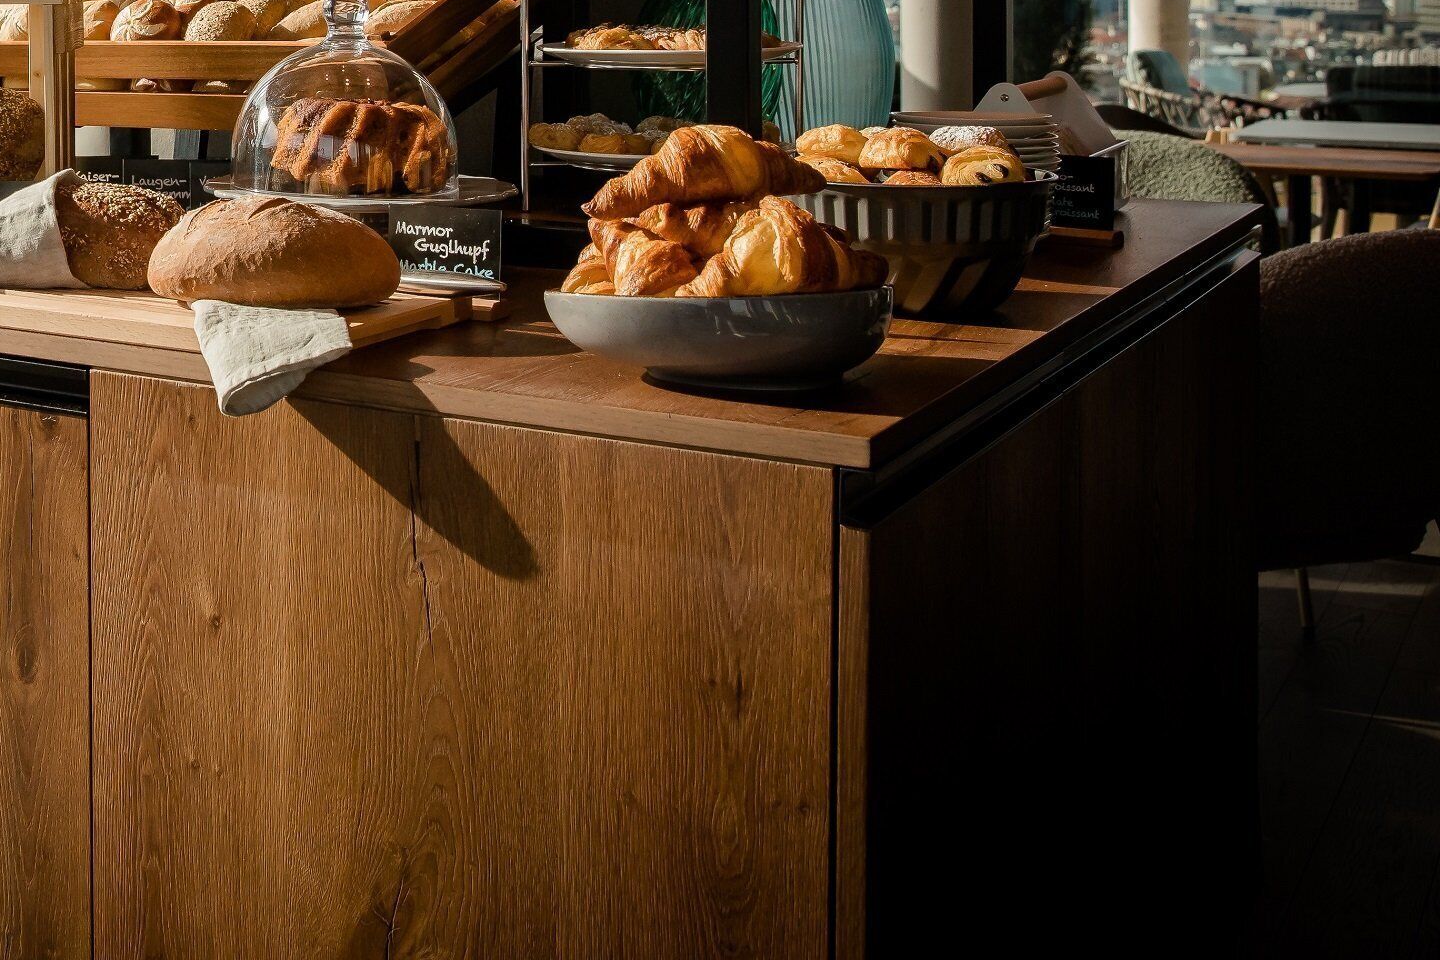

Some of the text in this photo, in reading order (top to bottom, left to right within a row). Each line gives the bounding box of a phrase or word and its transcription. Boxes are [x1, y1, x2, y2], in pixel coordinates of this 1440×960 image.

[131, 174, 187, 189] Laugen-
[395, 220, 454, 238] Marmor
[413, 237, 491, 265] Guglhupf
[453, 262, 495, 280] Cake
